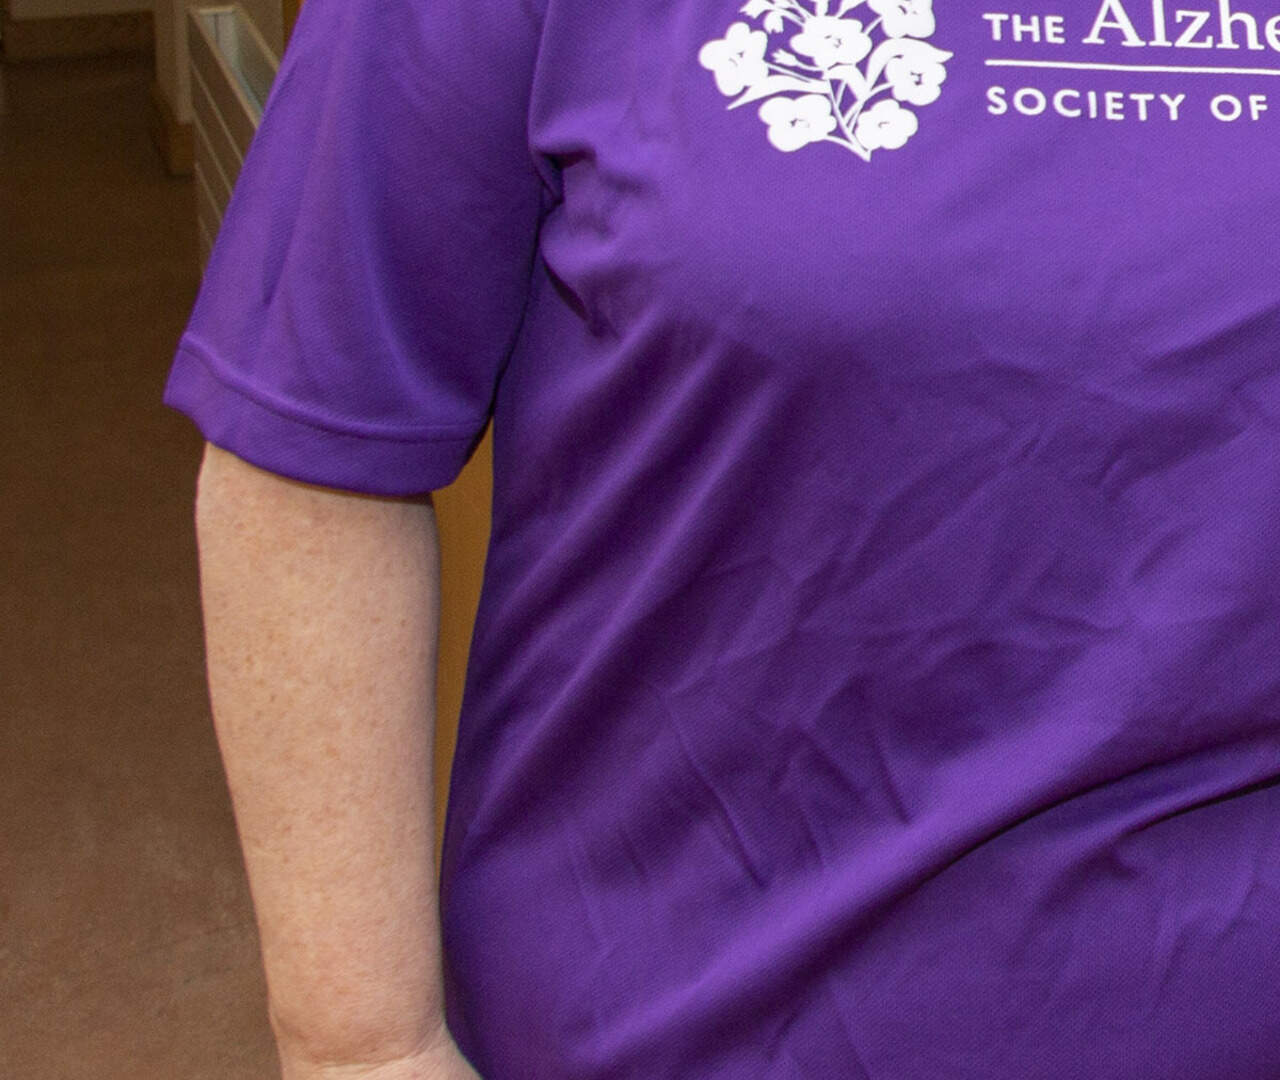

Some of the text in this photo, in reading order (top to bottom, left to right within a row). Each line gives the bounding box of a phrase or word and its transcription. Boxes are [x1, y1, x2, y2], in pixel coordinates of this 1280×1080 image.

[982, 13, 1066, 45] THE
[986, 86, 1187, 122] SOCIETY
[1210, 94, 1269, 123] OF
